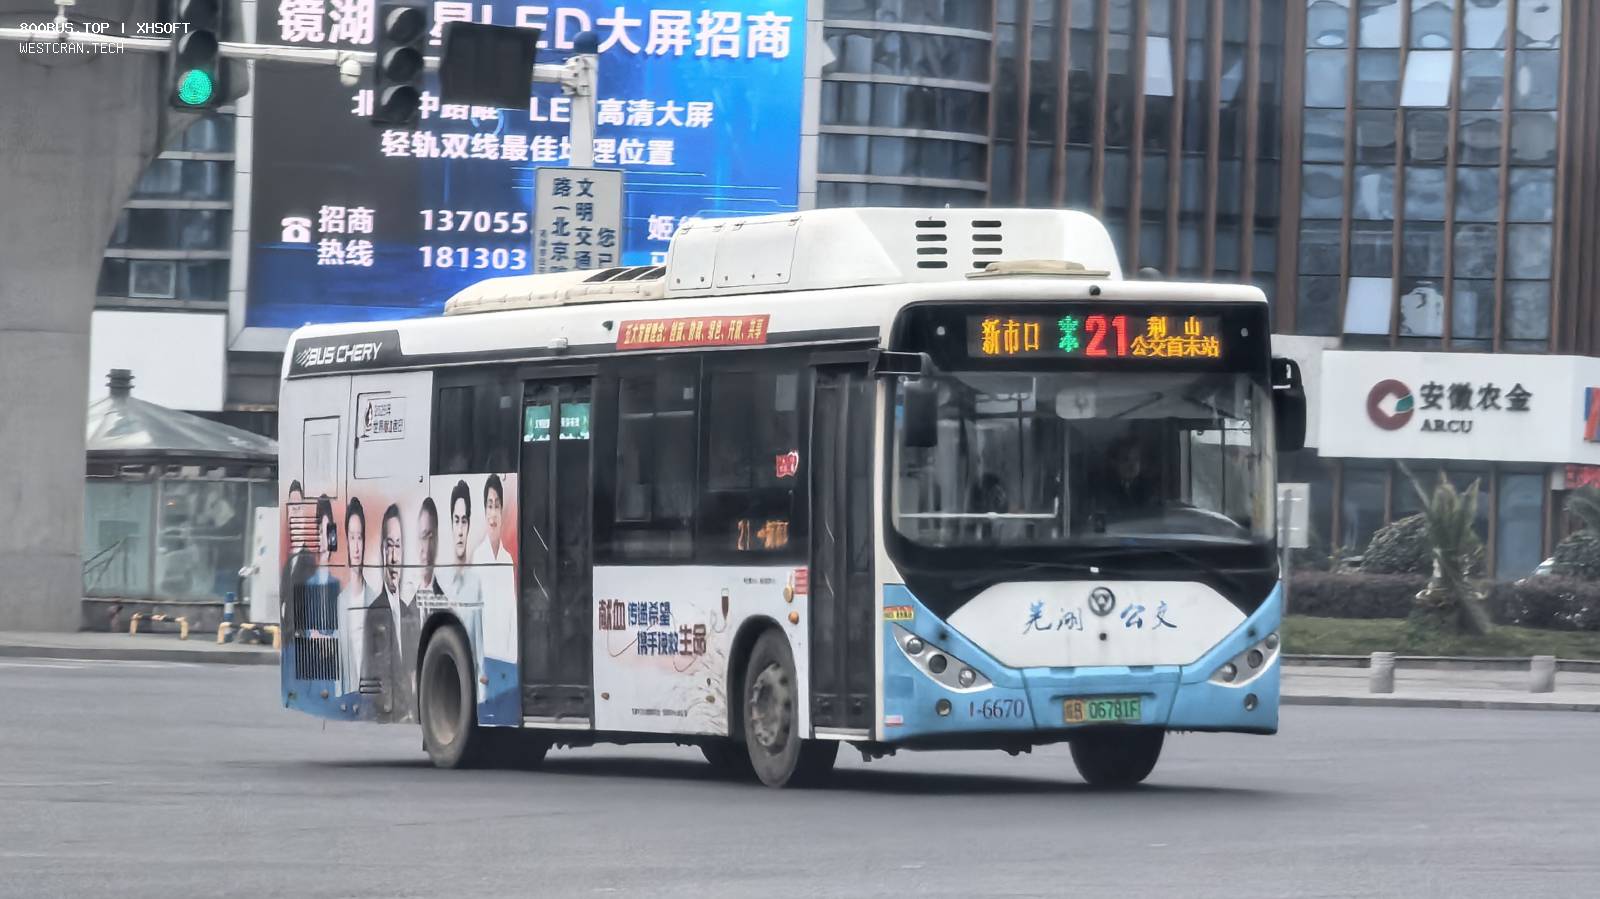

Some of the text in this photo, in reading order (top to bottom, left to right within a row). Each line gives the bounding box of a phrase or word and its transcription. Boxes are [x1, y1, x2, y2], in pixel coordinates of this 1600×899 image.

[318, 205, 376, 234] 招商
[419, 209, 529, 234] 137055
[317, 238, 375, 267] 热线
[418, 245, 527, 271] 181303
[981, 319, 1040, 355] 新市口
[1085, 315, 1128, 356] 21
[1130, 336, 1219, 357] 公交首末站
[307, 342, 383, 366] BUS CHERY
[1419, 381, 1533, 412] 安徽农金
[1420, 419, 1474, 434] ARCU
[1119, 600, 1178, 630] 公交
